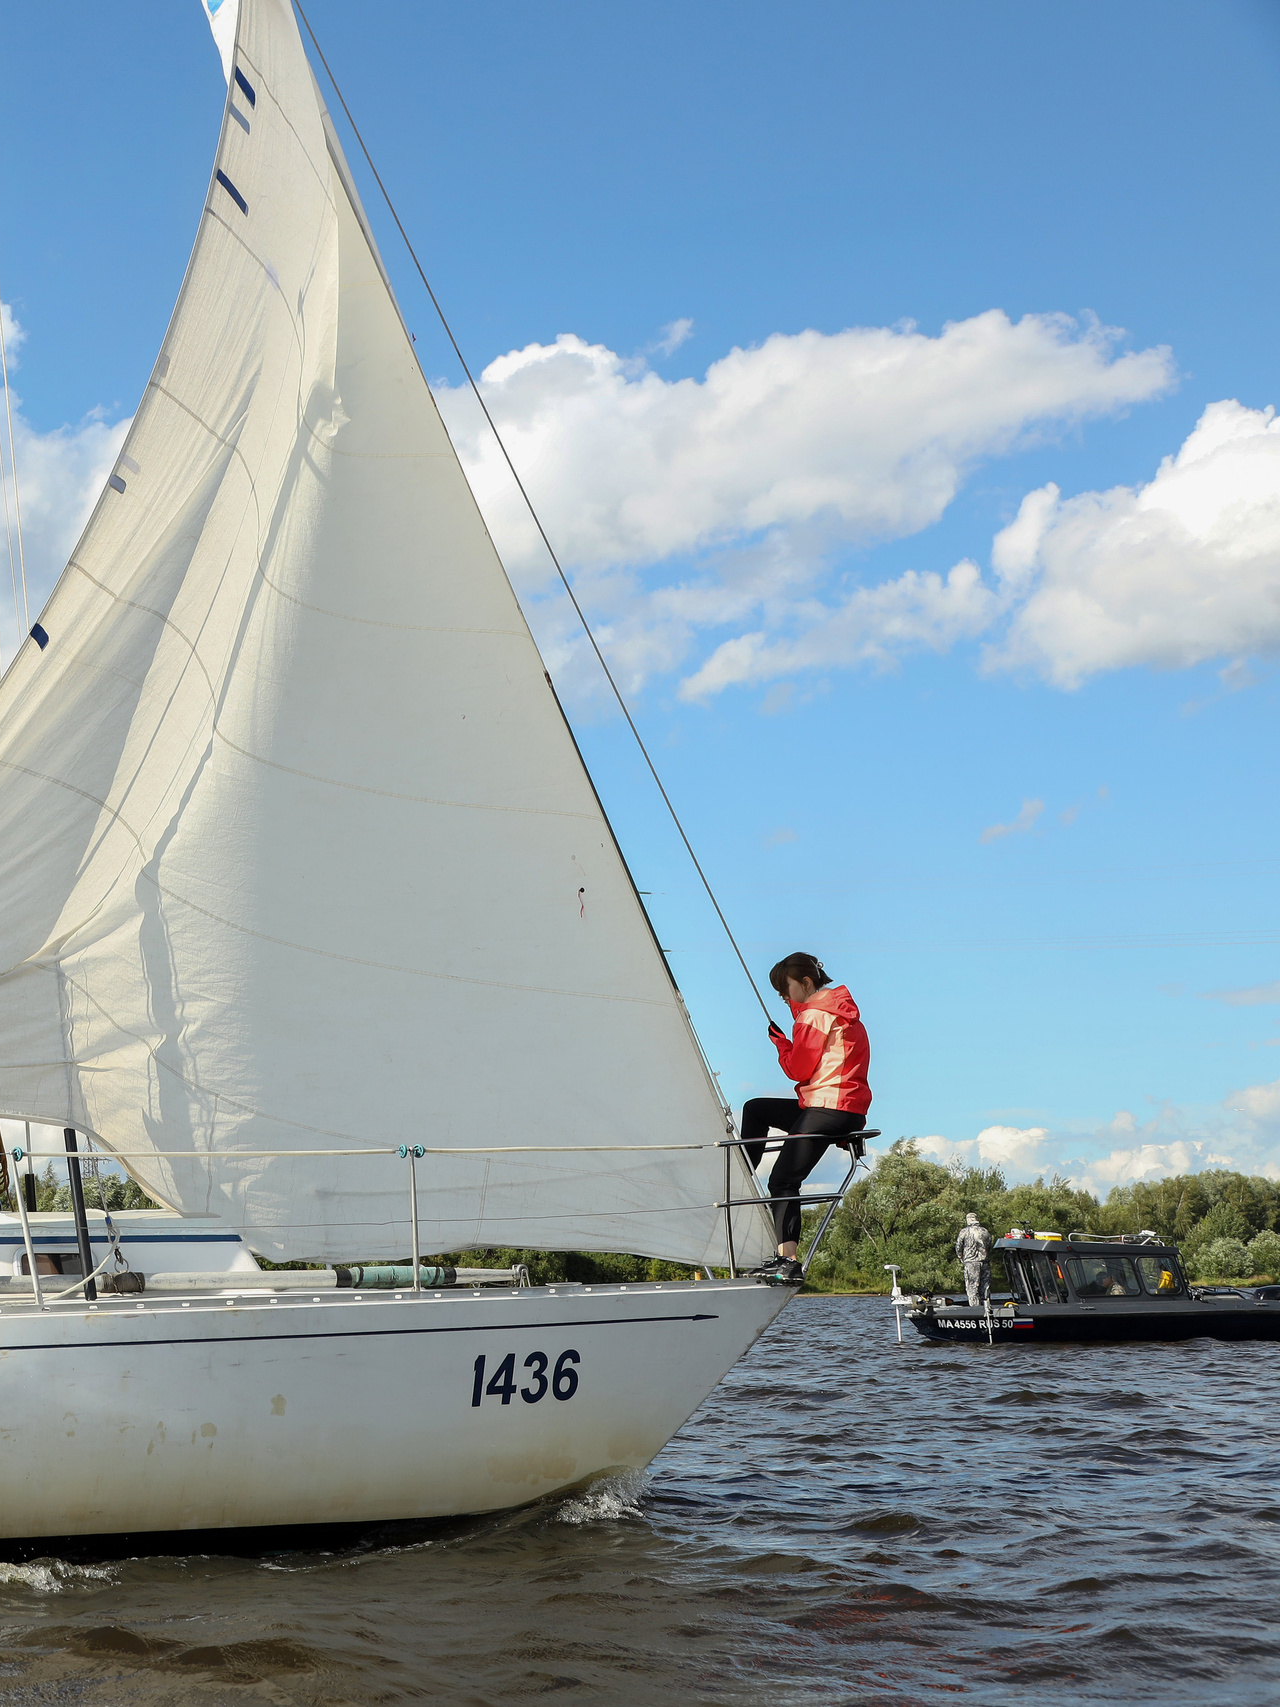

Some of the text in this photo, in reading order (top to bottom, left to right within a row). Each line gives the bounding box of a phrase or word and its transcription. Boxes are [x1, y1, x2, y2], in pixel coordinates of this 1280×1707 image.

[938, 1319, 1014, 1329] MA 4556 RUS 50
[471, 1348, 581, 1407] 1436
